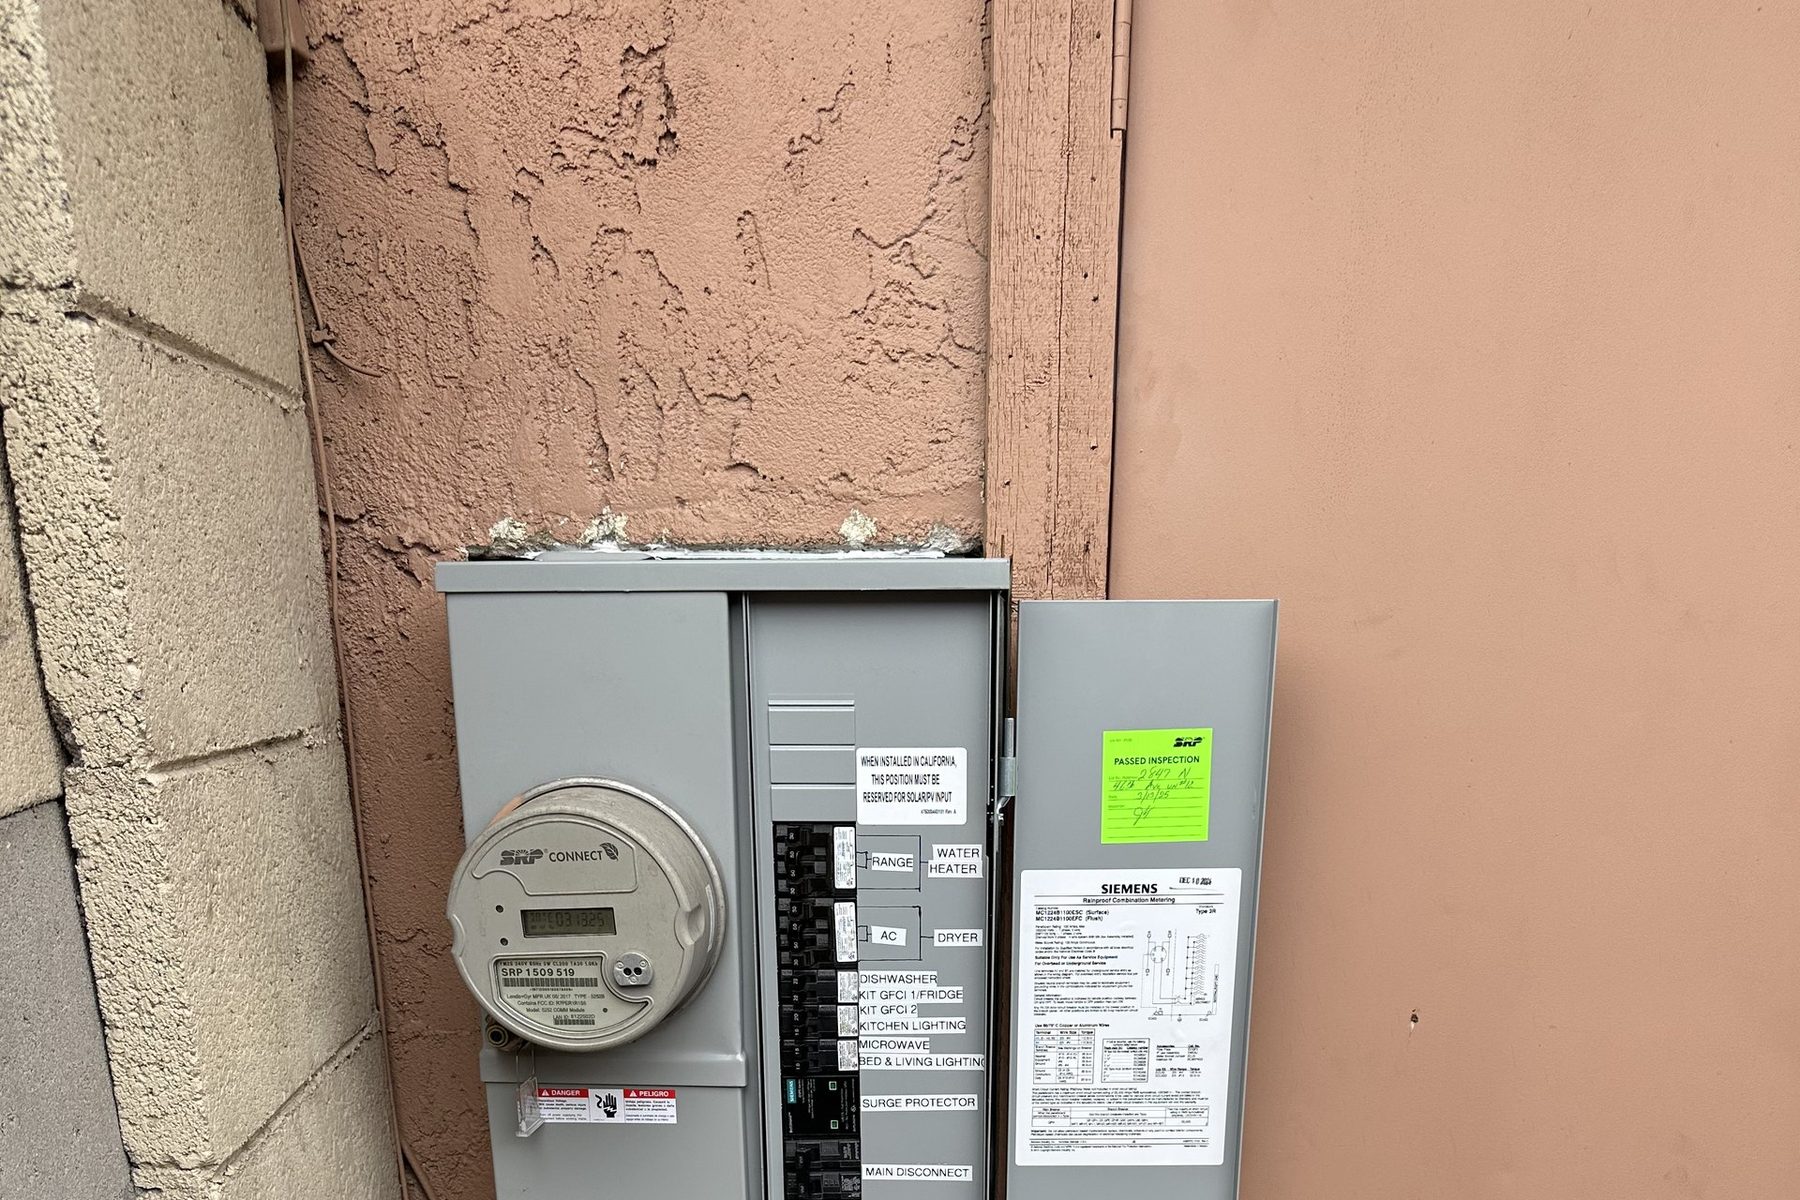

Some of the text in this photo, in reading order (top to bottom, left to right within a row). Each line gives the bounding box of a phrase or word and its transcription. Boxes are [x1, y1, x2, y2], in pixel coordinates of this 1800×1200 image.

[1173, 736, 1203, 747] SRP
[861, 755, 957, 768] WHEN INSTALLED IN CALIFORNIA,
[1114, 755, 1200, 765] PASSED INSPECTION
[1178, 767, 1191, 778] N
[871, 774, 940, 785] THIS POSITION MUST BE
[863, 791, 893, 803] RESERVED
[894, 791, 906, 802] FOR
[935, 791, 952, 802] INPUT
[500, 849, 603, 865] SRP CONNECT
[937, 848, 980, 858] WATER
[872, 856, 914, 868] RANGE
[929, 864, 977, 874] HEATER
[1101, 884, 1158, 894] SIEMENS
[880, 931, 897, 941] AC
[938, 933, 978, 943] DRYER
[501, 968, 575, 976] SRP 1509 519
[859, 974, 938, 984] DISHWASHER
[859, 990, 963, 1000] KIT GFCI 1/FRIDGE
[859, 1004, 917, 1015] KIT GFCI 2
[859, 1020, 966, 1031] KITCHEN LIGHTING
[859, 1040, 930, 1050] MICROWAVE
[859, 1056, 882, 1066] BED
[885, 1056, 892, 1066] &
[895, 1057, 932, 1066] LIVING
[862, 1097, 976, 1108] SURGE PROTECTOR
[865, 1167, 969, 1178] MAIN DISCONNECT
